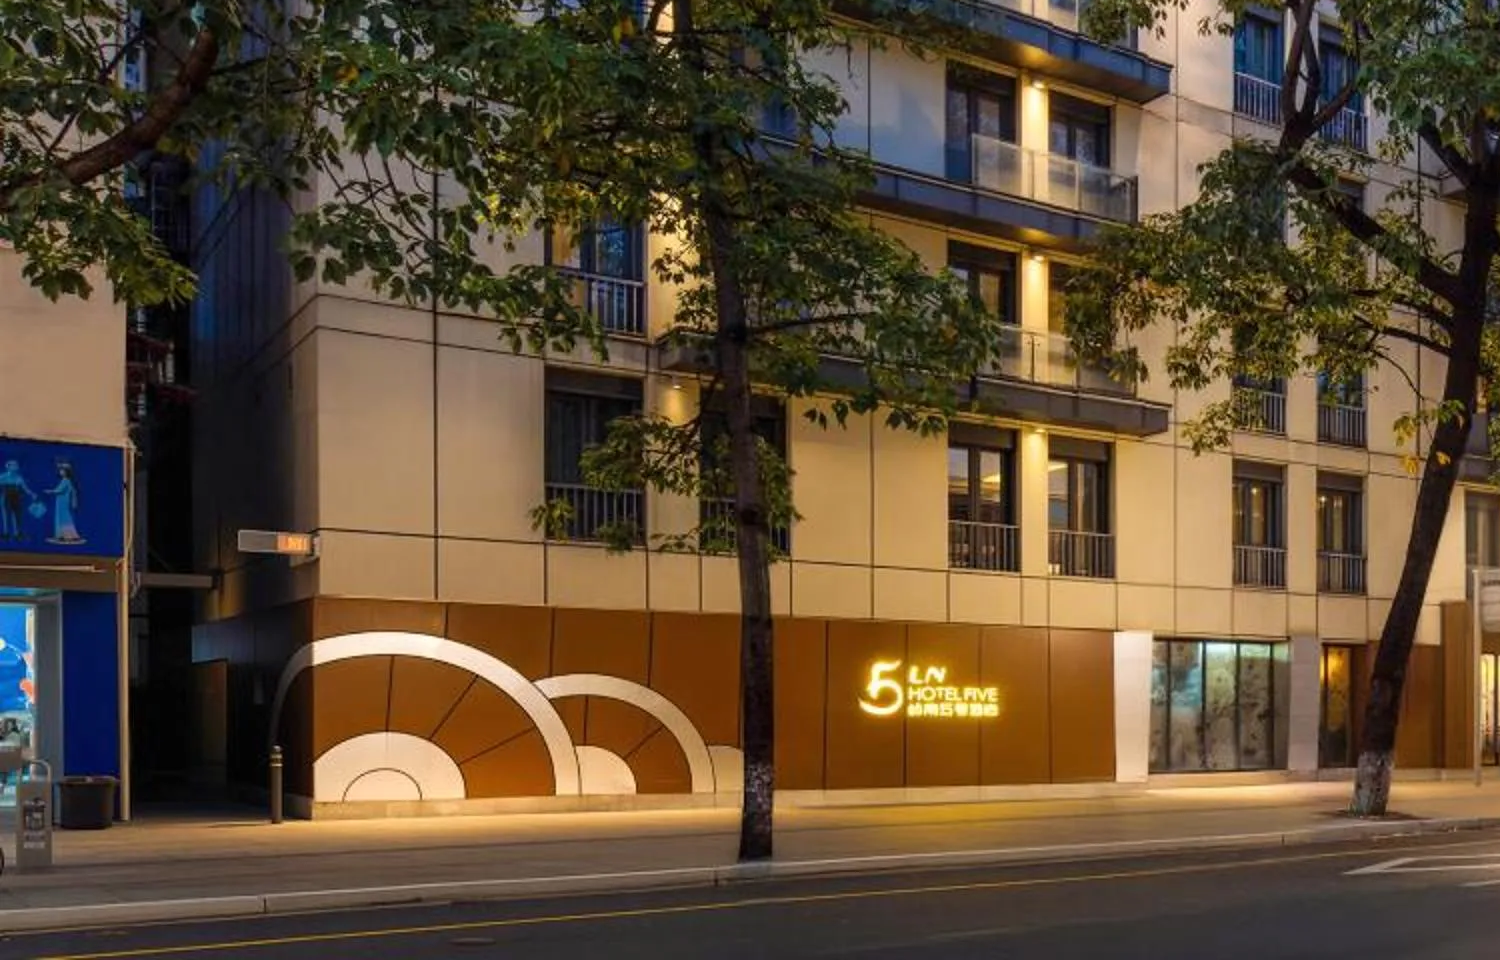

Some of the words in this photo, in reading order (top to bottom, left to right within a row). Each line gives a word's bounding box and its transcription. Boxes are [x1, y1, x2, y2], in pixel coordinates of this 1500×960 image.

[908, 665, 947, 685] LN
[858, 659, 903, 715] 5
[908, 687, 962, 702] HOTEL
[963, 687, 999, 702] FIVE
